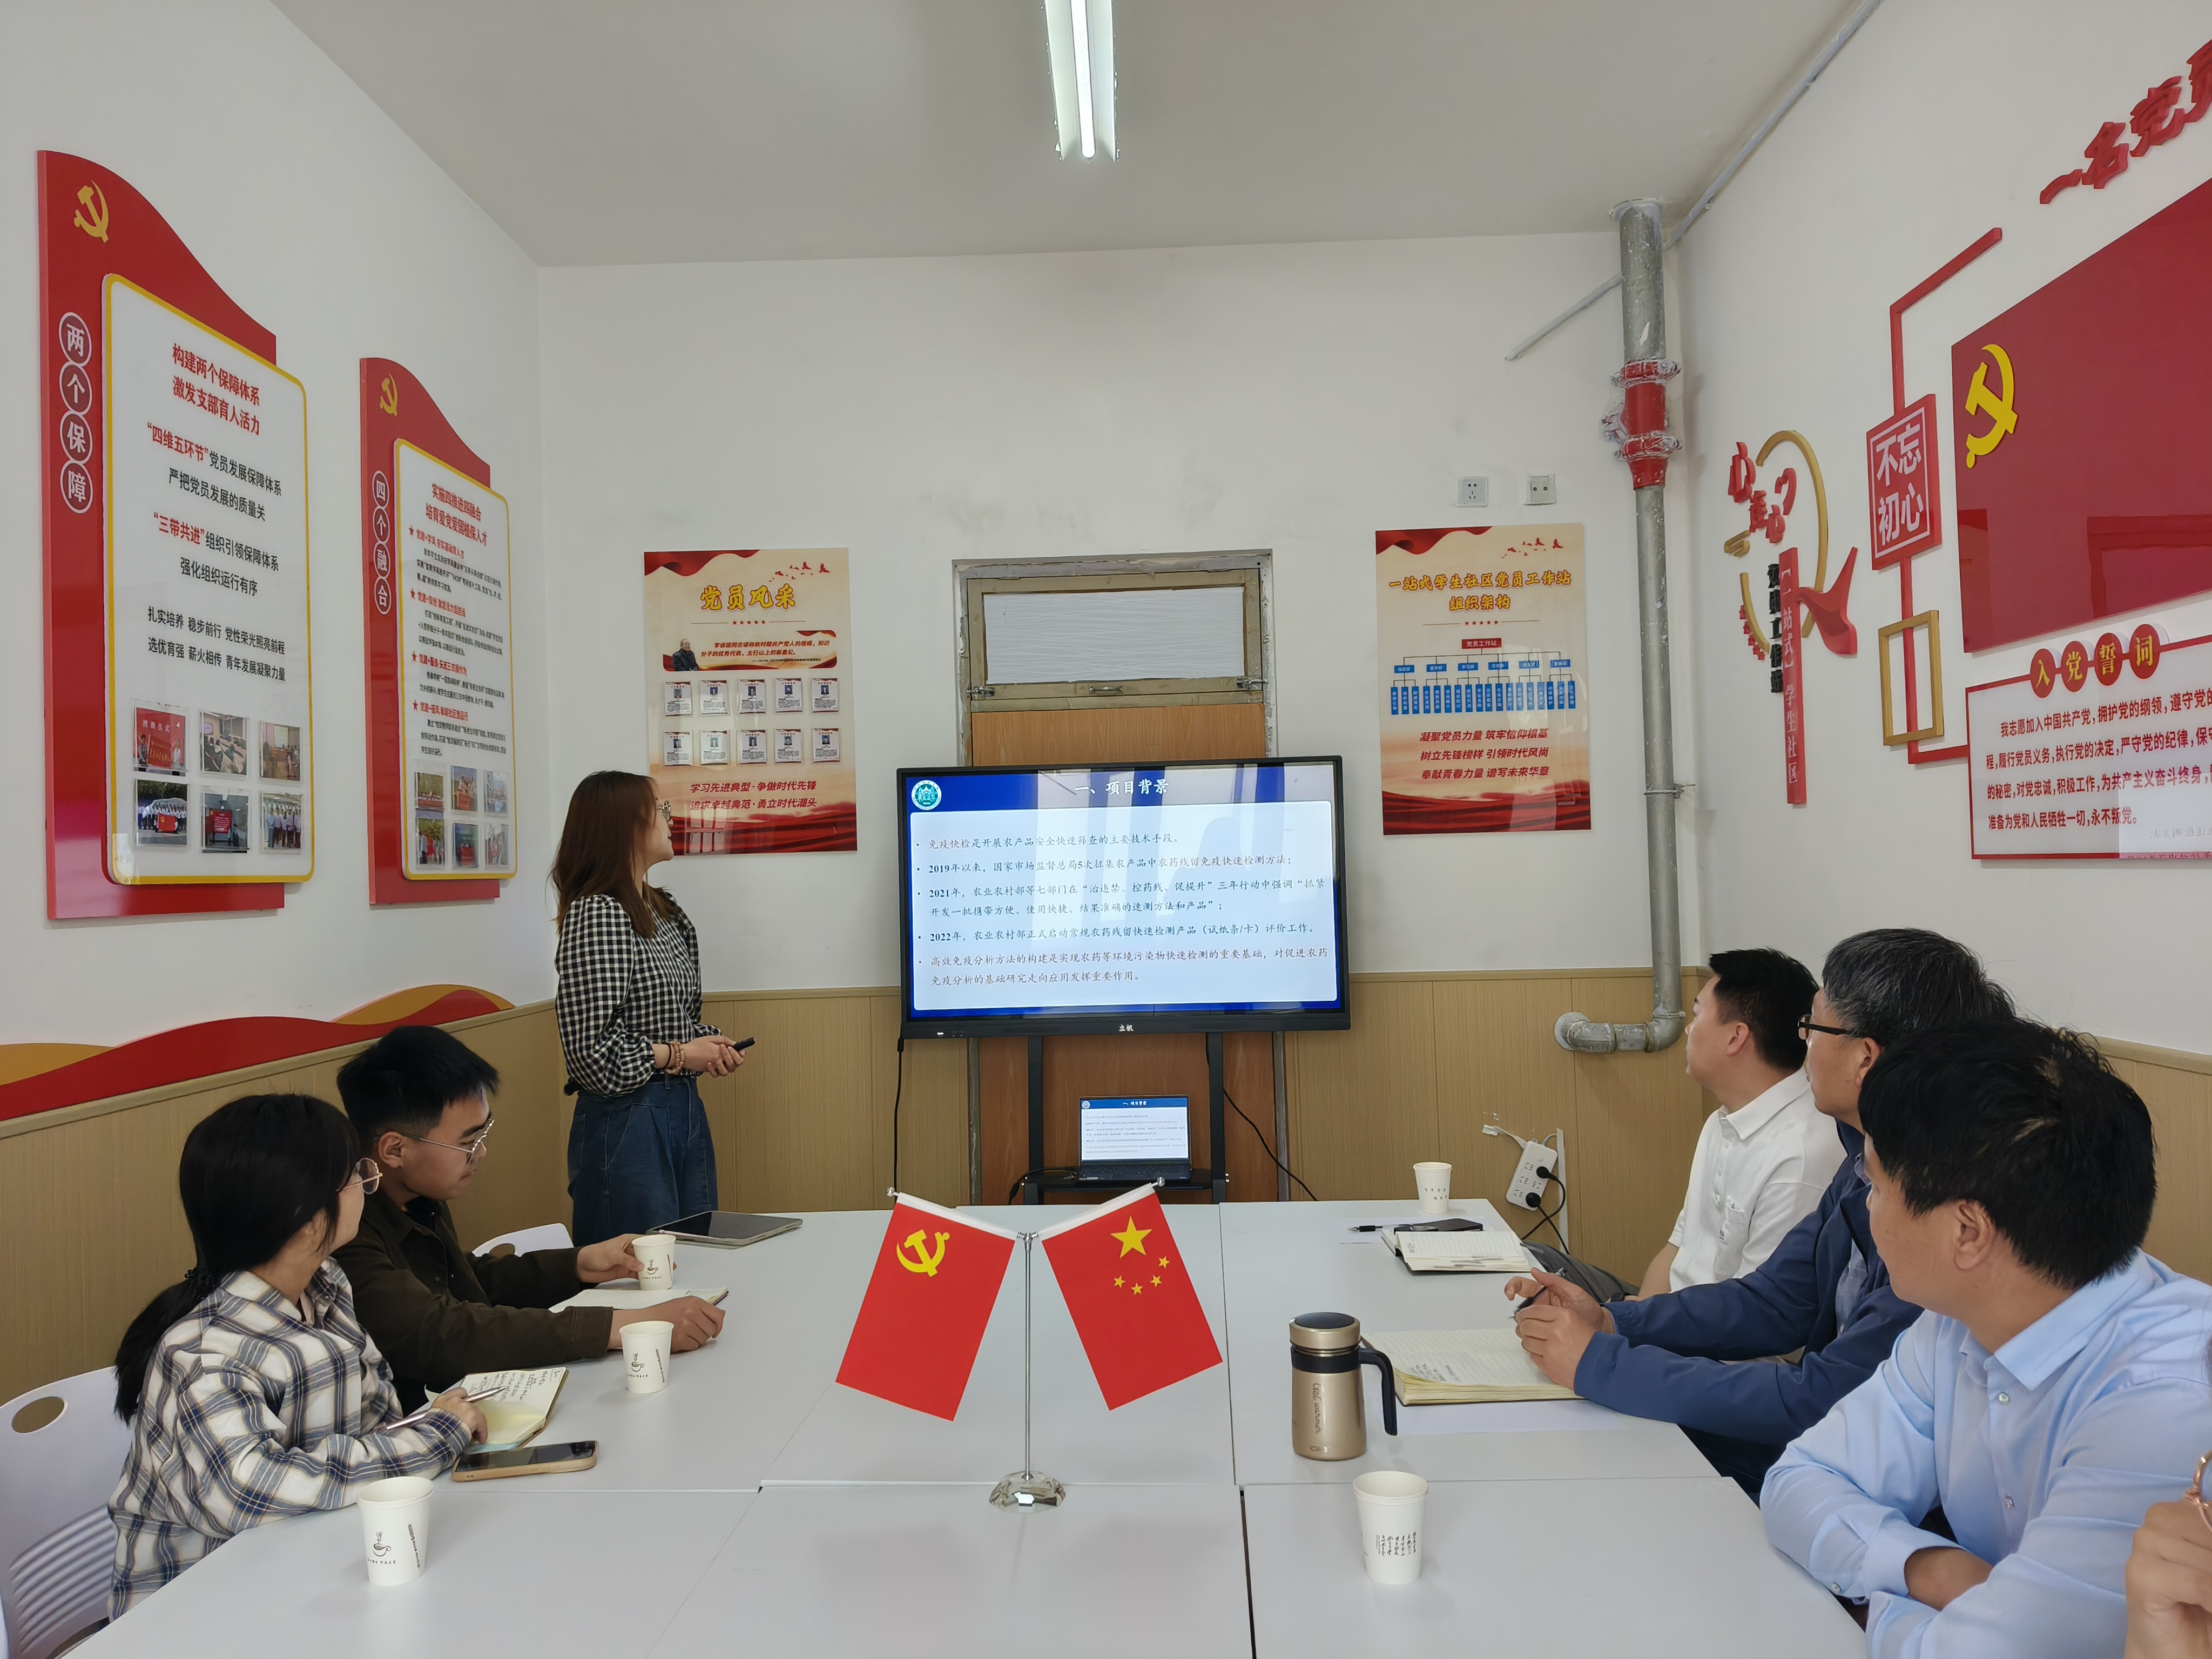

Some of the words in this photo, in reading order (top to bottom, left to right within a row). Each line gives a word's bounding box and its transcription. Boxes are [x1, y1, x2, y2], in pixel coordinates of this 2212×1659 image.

[172, 342, 260, 407] 构建两个保障体系
[65, 323, 87, 503] 两个保障
[172, 375, 260, 436] 激发支部育人活力
[1876, 423, 1921, 486] 不忘
[168, 467, 266, 521] 严把党员发展的质量关
[426, 502, 488, 546] 培育爱党爱国植保人才
[1878, 482, 1924, 547] 初心
[376, 480, 389, 607] 四个融合
[180, 557, 258, 597] 强化组织运行有序
[700, 583, 797, 611] 党员风采
[1389, 570, 1572, 591] 一站式学生社区党员工作站
[1448, 594, 1511, 611] 组织架构
[147, 606, 184, 630] 扎实培养
[188, 616, 221, 639] 稳步前行
[225, 626, 285, 655] 党性荣光照亮前程
[1466, 639, 1498, 648] 党员工作站
[147, 636, 185, 659] 选优育强
[188, 646, 222, 667] 薪火相传
[226, 654, 286, 682] 青年发展凝聚力量
[2035, 635, 2154, 689] 入党誓词
[1419, 730, 1483, 743] 凝聚党员力量
[1485, 728, 1549, 740] 筑牢信仰根基
[1420, 748, 1484, 761] 树立先锋榜样
[1486, 747, 1549, 759] 引领时代风尚
[690, 780, 817, 794] 学习先进典型·争做时代先锋
[1074, 778, 1170, 795] 一、项目背景
[1421, 768, 1484, 780] 奉献青春力量
[1486, 766, 1549, 778] 谱写未来华章
[1987, 764, 2212, 800] 的秘密，对党忠诚，积极工作，为共产主义奋斗终身，
[929, 833, 1178, 850] 免疫快检是开展农产品安全快速筛查的主要技术手段。
